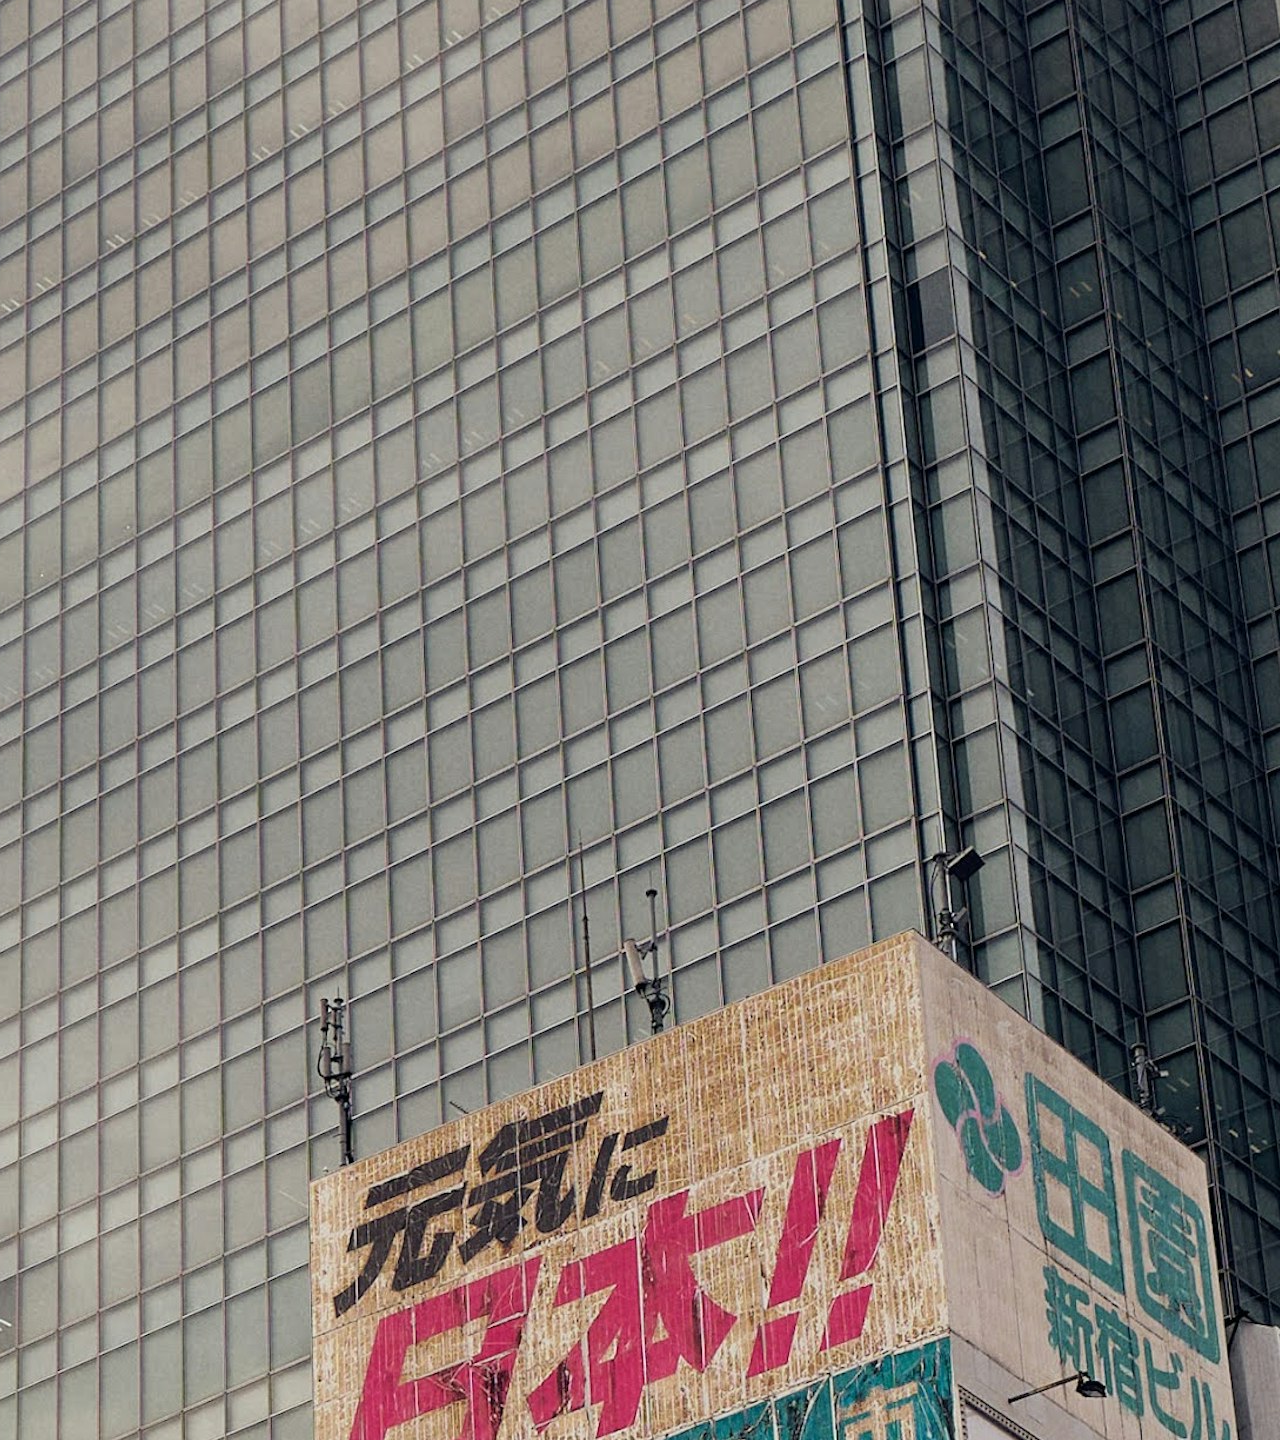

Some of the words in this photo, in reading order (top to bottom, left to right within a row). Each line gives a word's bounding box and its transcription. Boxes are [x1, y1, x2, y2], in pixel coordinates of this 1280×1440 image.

[333, 1090, 671, 1318] 元気に
[1023, 1071, 1223, 1364] 田園
